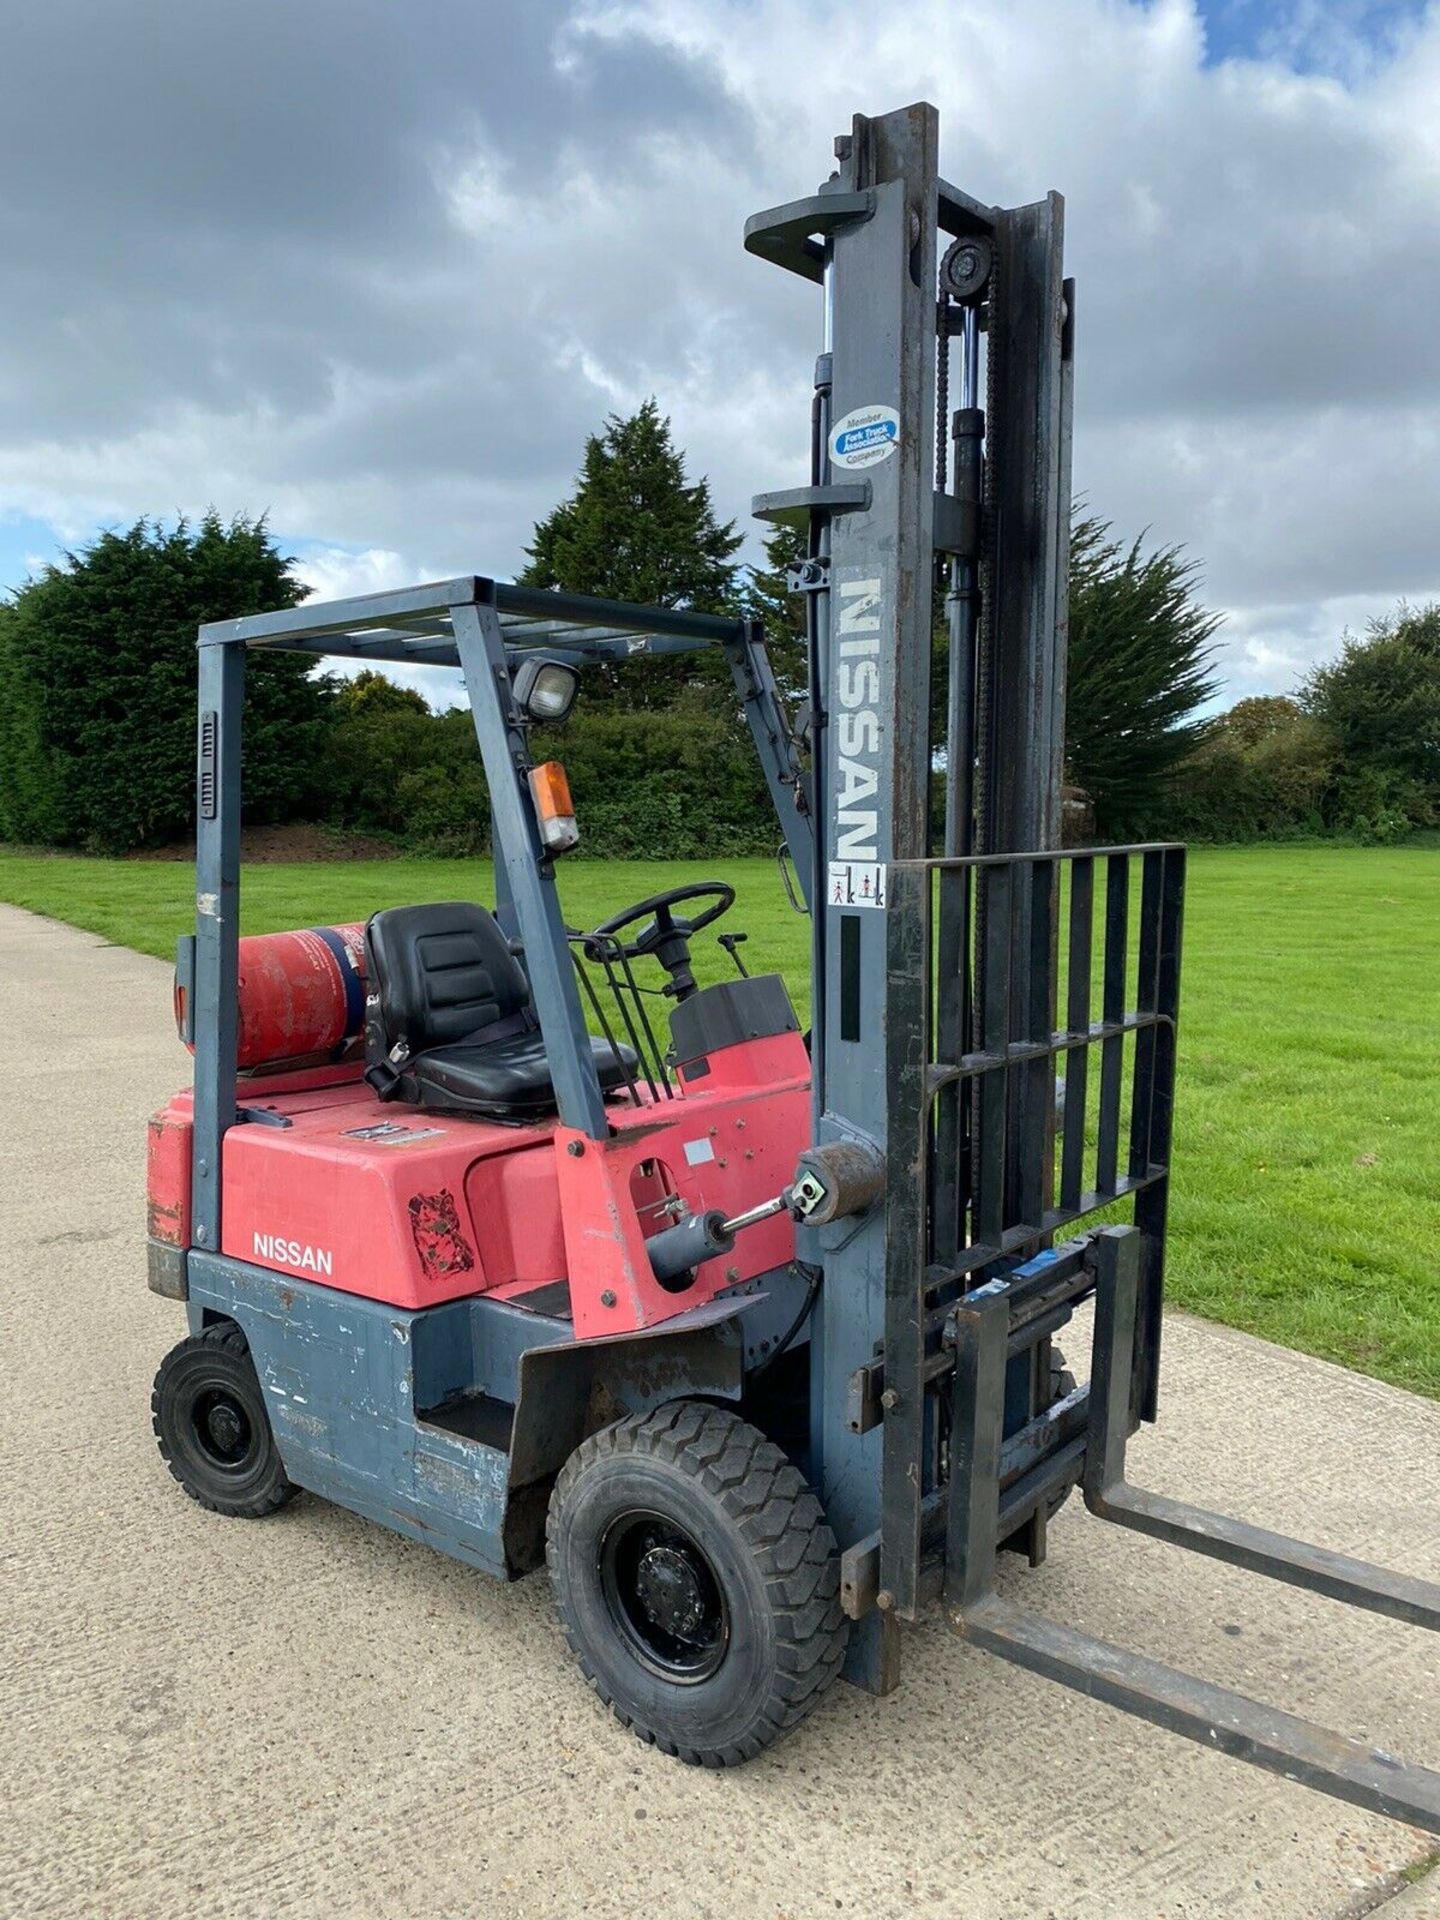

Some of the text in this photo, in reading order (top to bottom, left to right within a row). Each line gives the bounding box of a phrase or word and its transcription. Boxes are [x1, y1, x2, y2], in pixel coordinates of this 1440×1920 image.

[847, 414, 882, 427] Member
[845, 423, 888, 442] Fork Truck
[846, 449, 884, 464] Company
[838, 580, 881, 860] NISSAN
[254, 1231, 332, 1275] NISSAN
